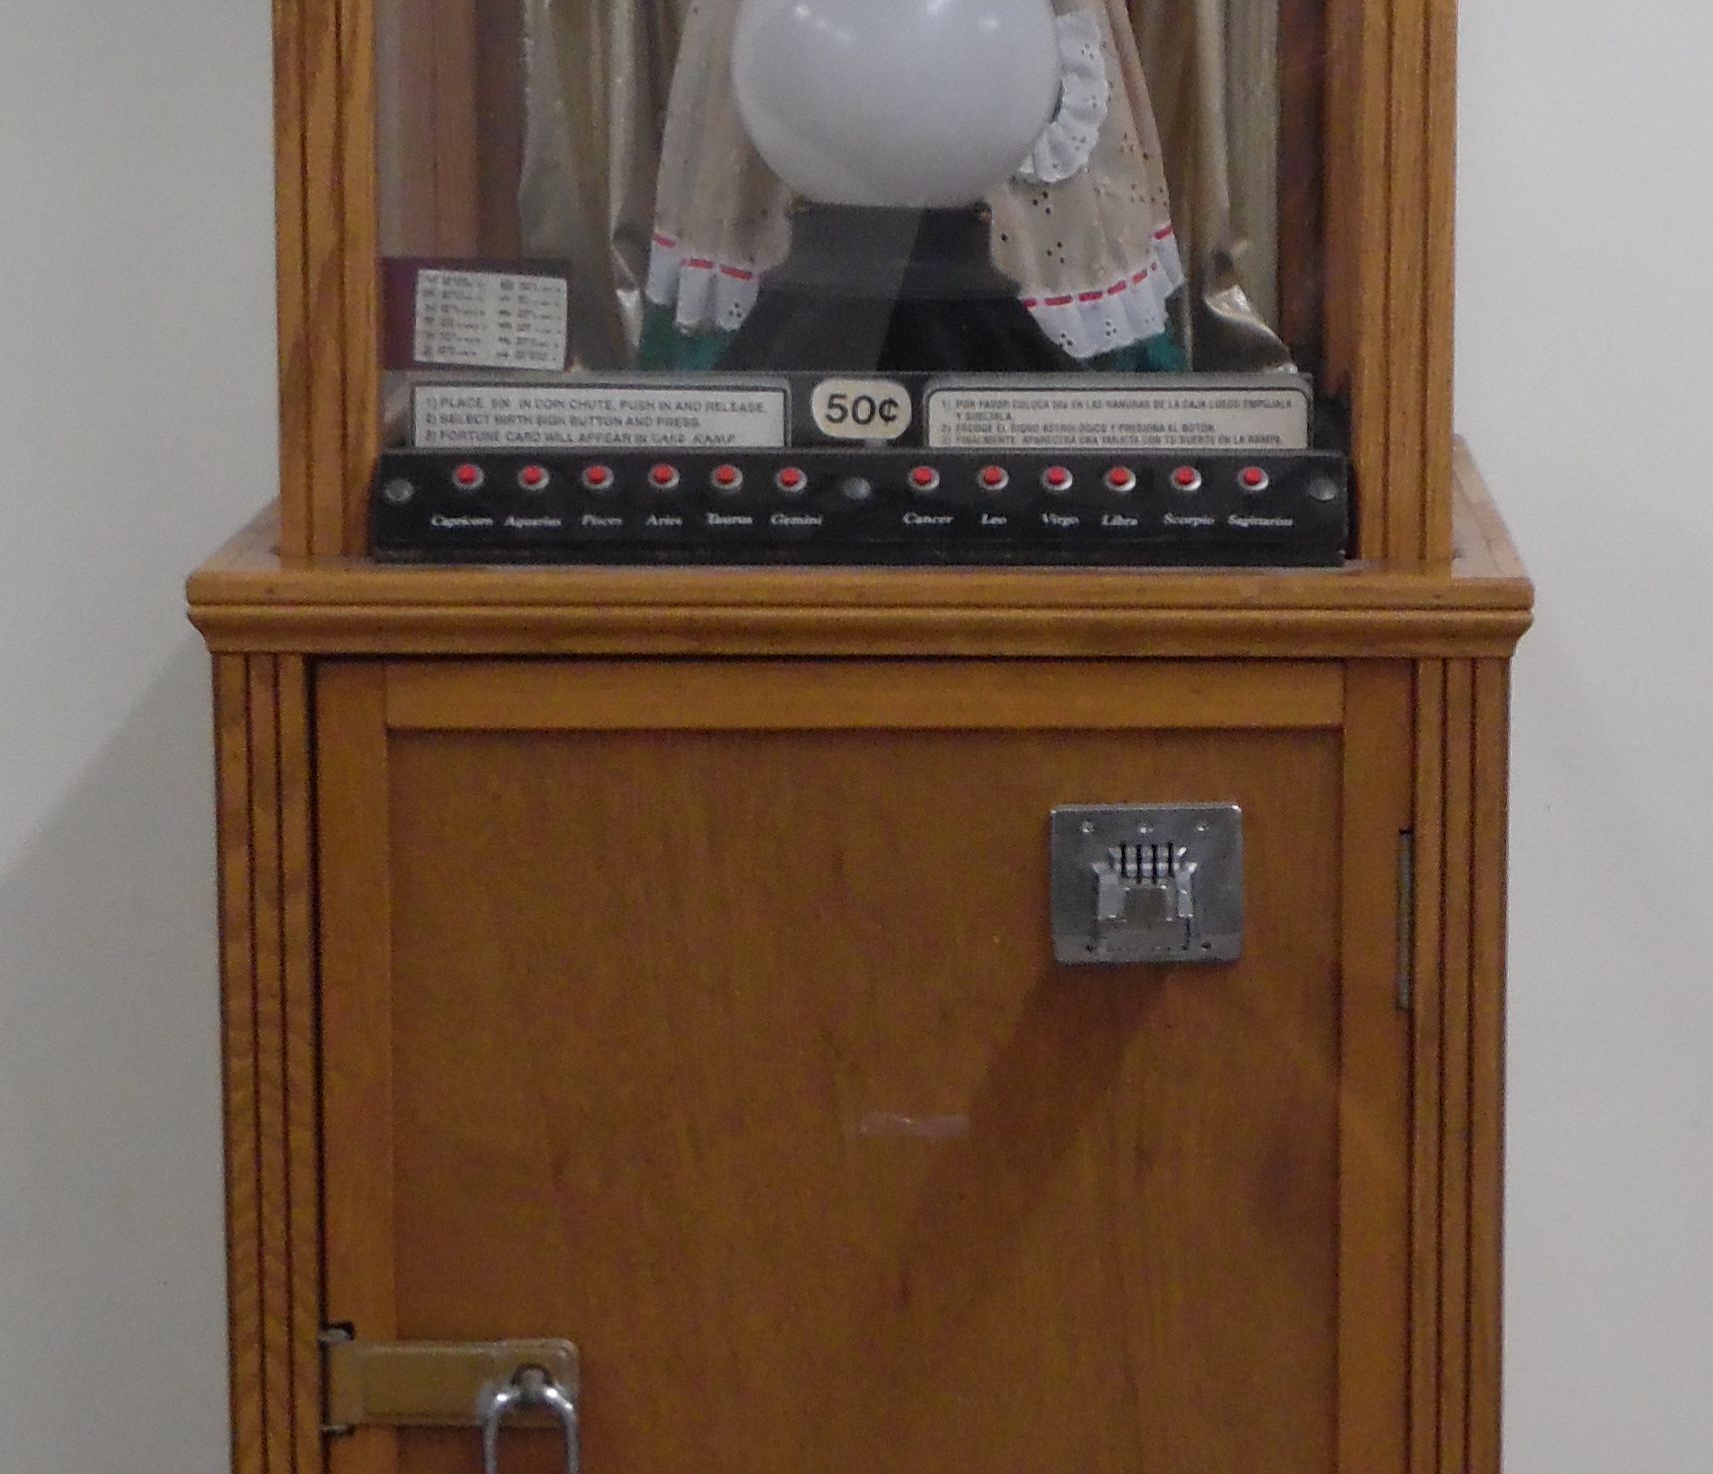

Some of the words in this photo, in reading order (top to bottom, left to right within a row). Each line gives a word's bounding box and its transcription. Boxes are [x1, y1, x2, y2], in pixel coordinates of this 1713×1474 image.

[440, 398, 483, 409] PLACE
[519, 399, 532, 410] IN
[535, 399, 566, 410] COIN
[620, 401, 655, 412] PUSH
[659, 401, 672, 412] IN
[675, 401, 702, 412] AND
[825, 393, 899, 425] 50¢
[440, 414, 489, 425] SELECT
[495, 414, 532, 425] BIRTH
[570, 415, 623, 426] BUTTON
[626, 416, 653, 427] AND
[440, 431, 500, 442] FORTUNE
[505, 431, 541, 442] CARD
[545, 432, 575, 443] WILL
[578, 433, 632, 444] APPEAR
[645, 514, 683, 526] Aries
[706, 512, 753, 526] Taurus
[769, 513, 823, 526] Gemini
[902, 512, 954, 525] Cancer
[981, 512, 1008, 525] Leo
[1041, 512, 1080, 527] Virgo
[1100, 513, 1139, 526] Libra
[1163, 512, 1215, 527] Scorpio
